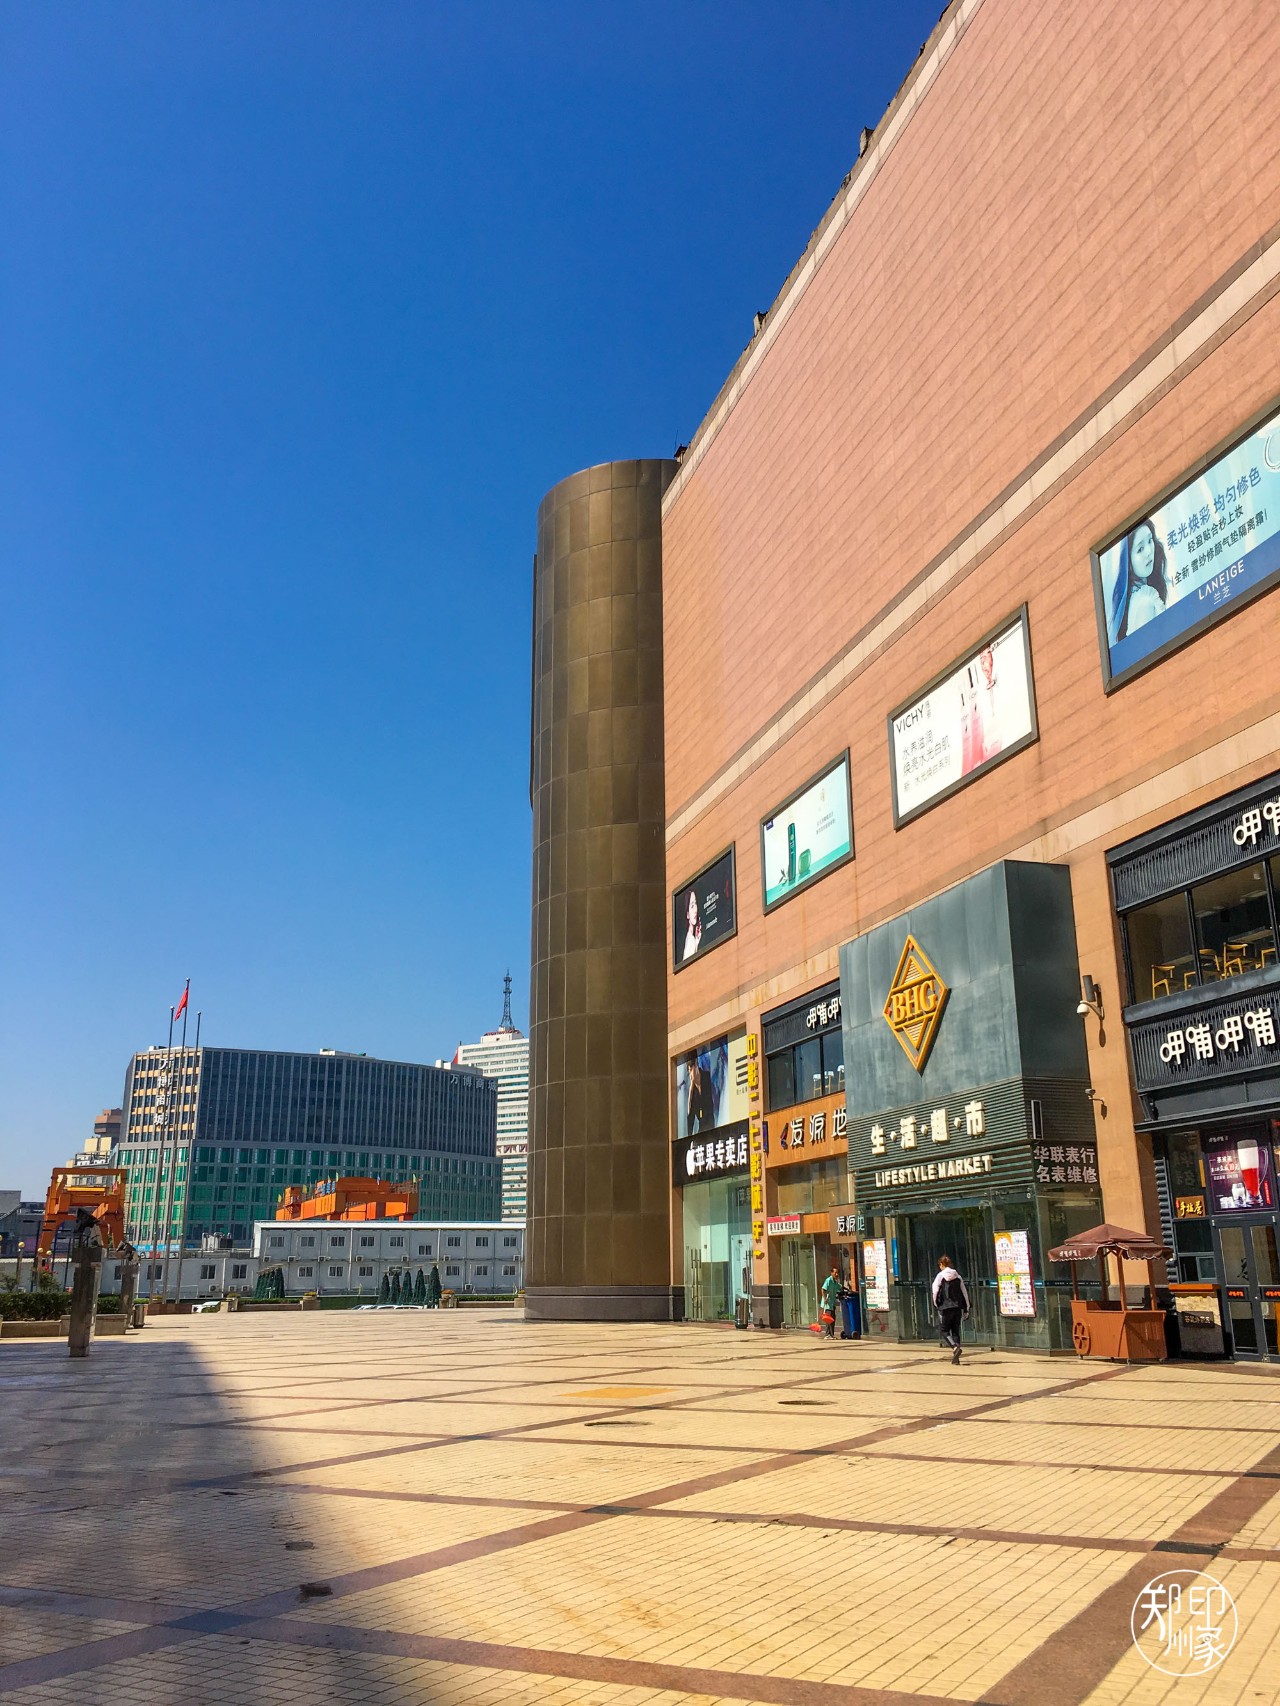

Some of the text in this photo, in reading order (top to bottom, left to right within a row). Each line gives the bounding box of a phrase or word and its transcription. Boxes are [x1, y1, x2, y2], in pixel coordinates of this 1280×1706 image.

[1167, 466, 1262, 550] 柔光焕彩 均匀修色
[1187, 504, 1244, 554] 轻盈贴合秒上妆
[1198, 559, 1245, 600] LANEIGE
[896, 704, 924, 733] VICHY
[890, 981, 938, 1023] BHG
[1160, 1008, 1276, 1065] 呷哺呷哺
[450, 1073, 497, 1091] 万博商城
[695, 1133, 748, 1173] 苹果专卖店
[875, 1155, 993, 1188] LIFESTYLE MARKET
[1033, 1145, 1096, 1164] 华联表行
[1036, 1165, 1098, 1183] 名表维修
